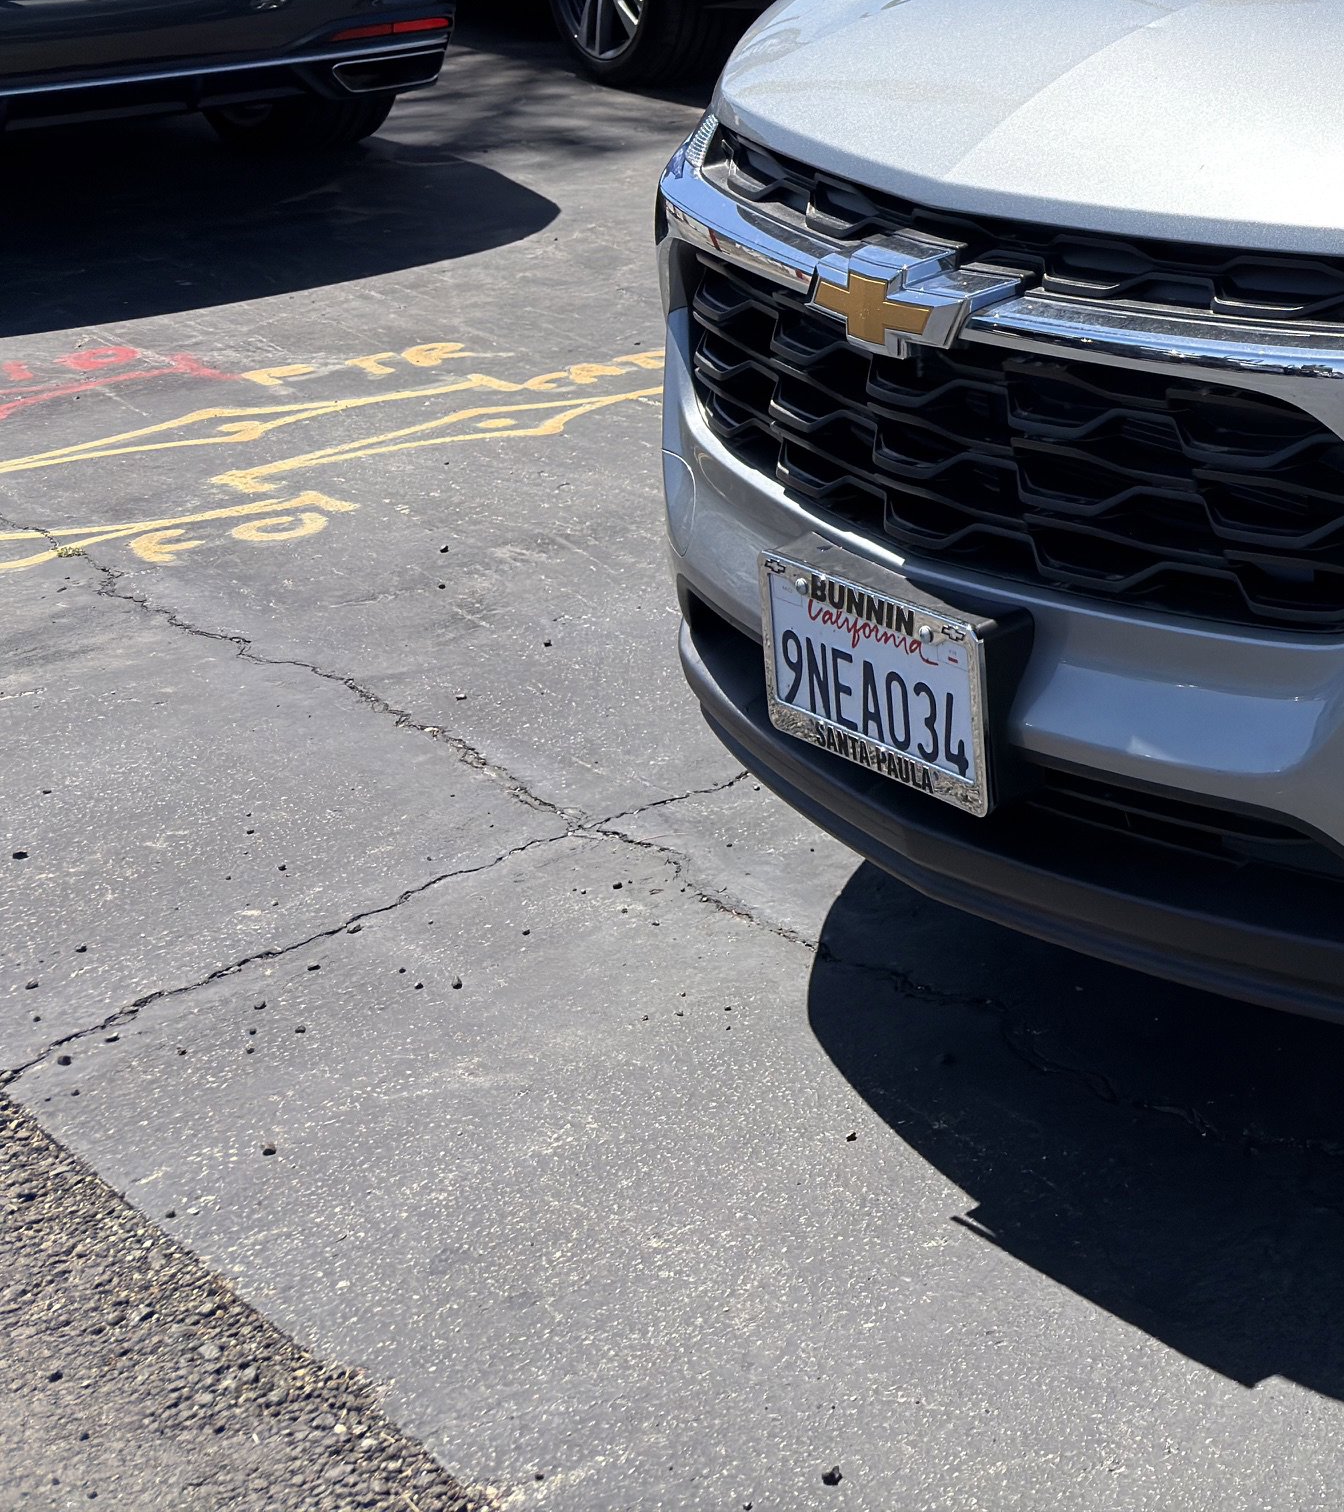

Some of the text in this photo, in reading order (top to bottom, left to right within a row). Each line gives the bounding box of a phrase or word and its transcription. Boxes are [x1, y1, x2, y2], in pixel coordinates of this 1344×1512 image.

[807, 599, 938, 666] California
[810, 573, 915, 637] BUNNIN
[781, 629, 970, 778] 9NEA034
[815, 720, 935, 794] SANTA PAULA
